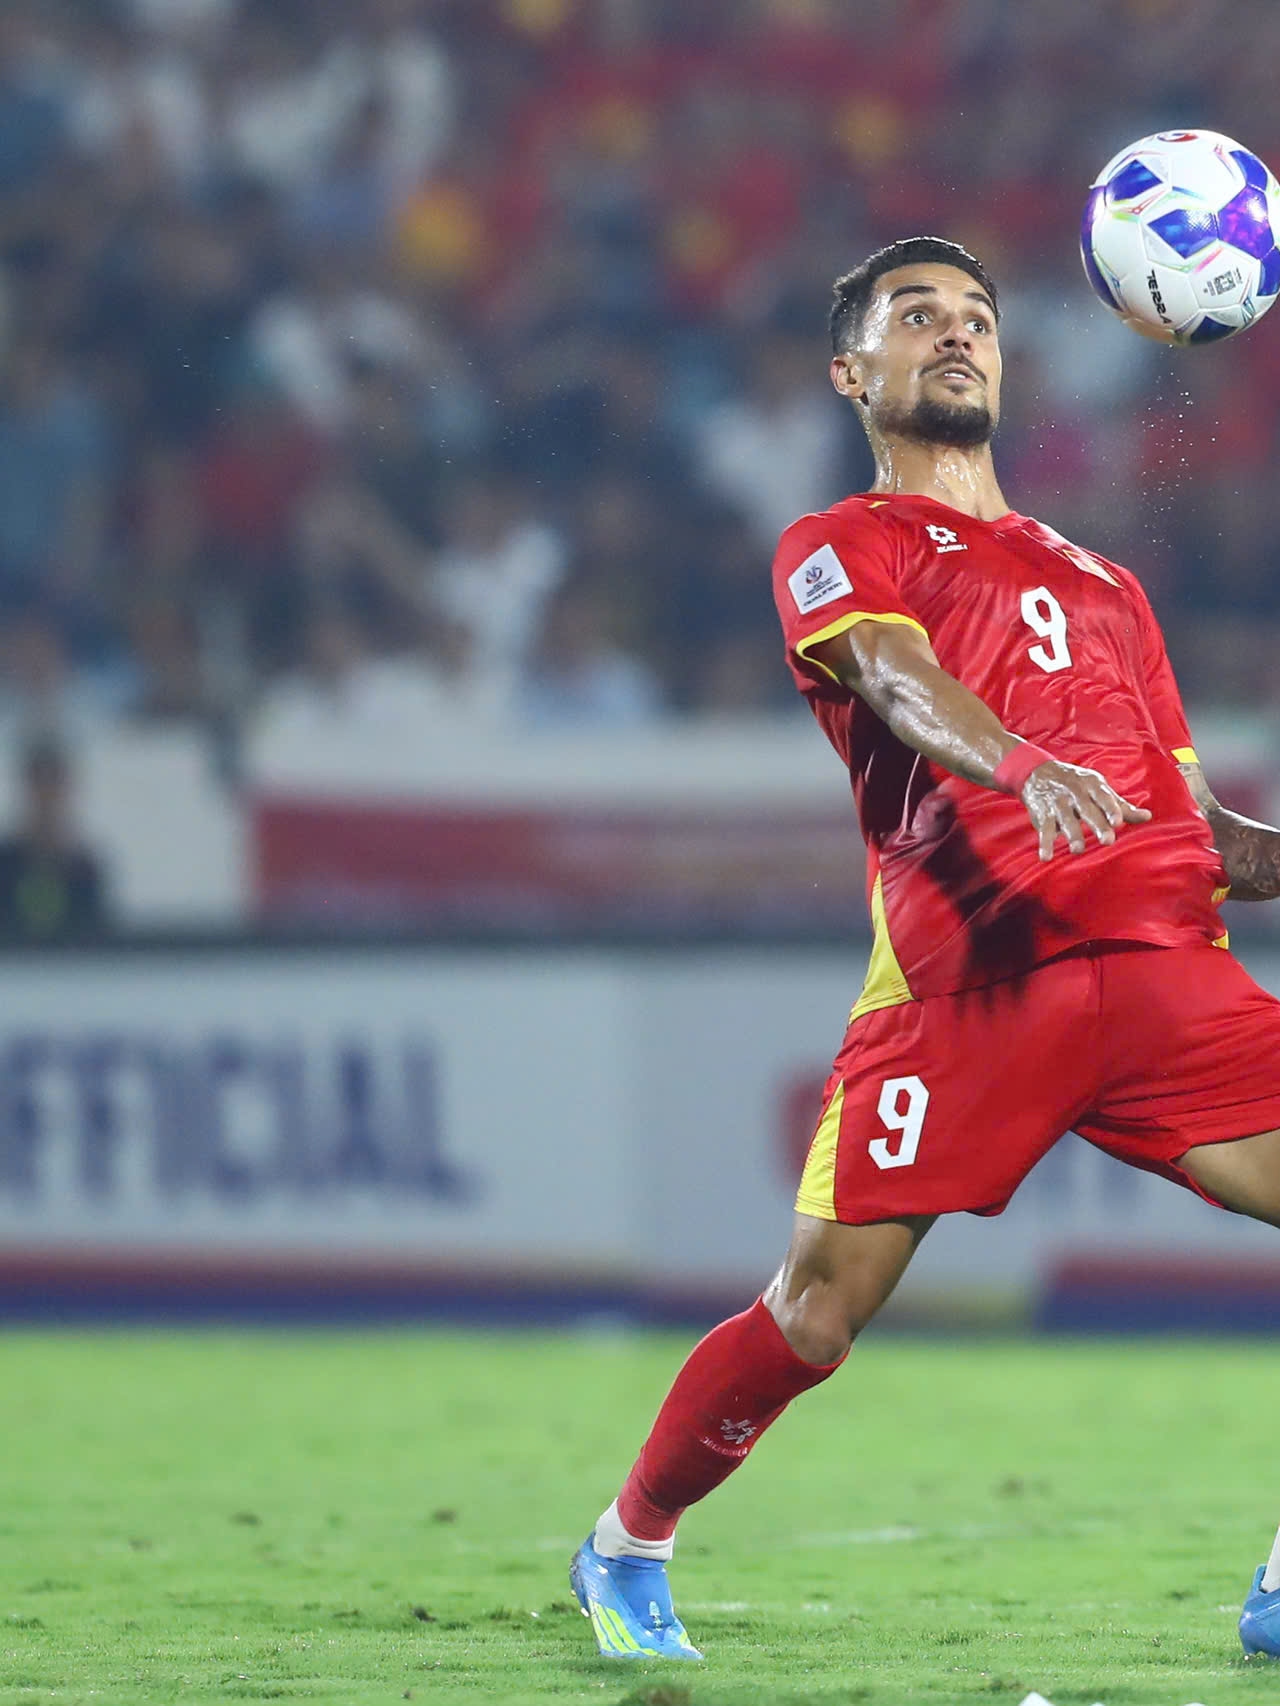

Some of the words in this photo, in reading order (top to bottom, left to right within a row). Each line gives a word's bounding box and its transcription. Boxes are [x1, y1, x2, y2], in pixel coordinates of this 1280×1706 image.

[1146, 269, 1173, 324] TERRA
[1021, 585, 1073, 673] 9
[867, 1075, 931, 1170] 9
